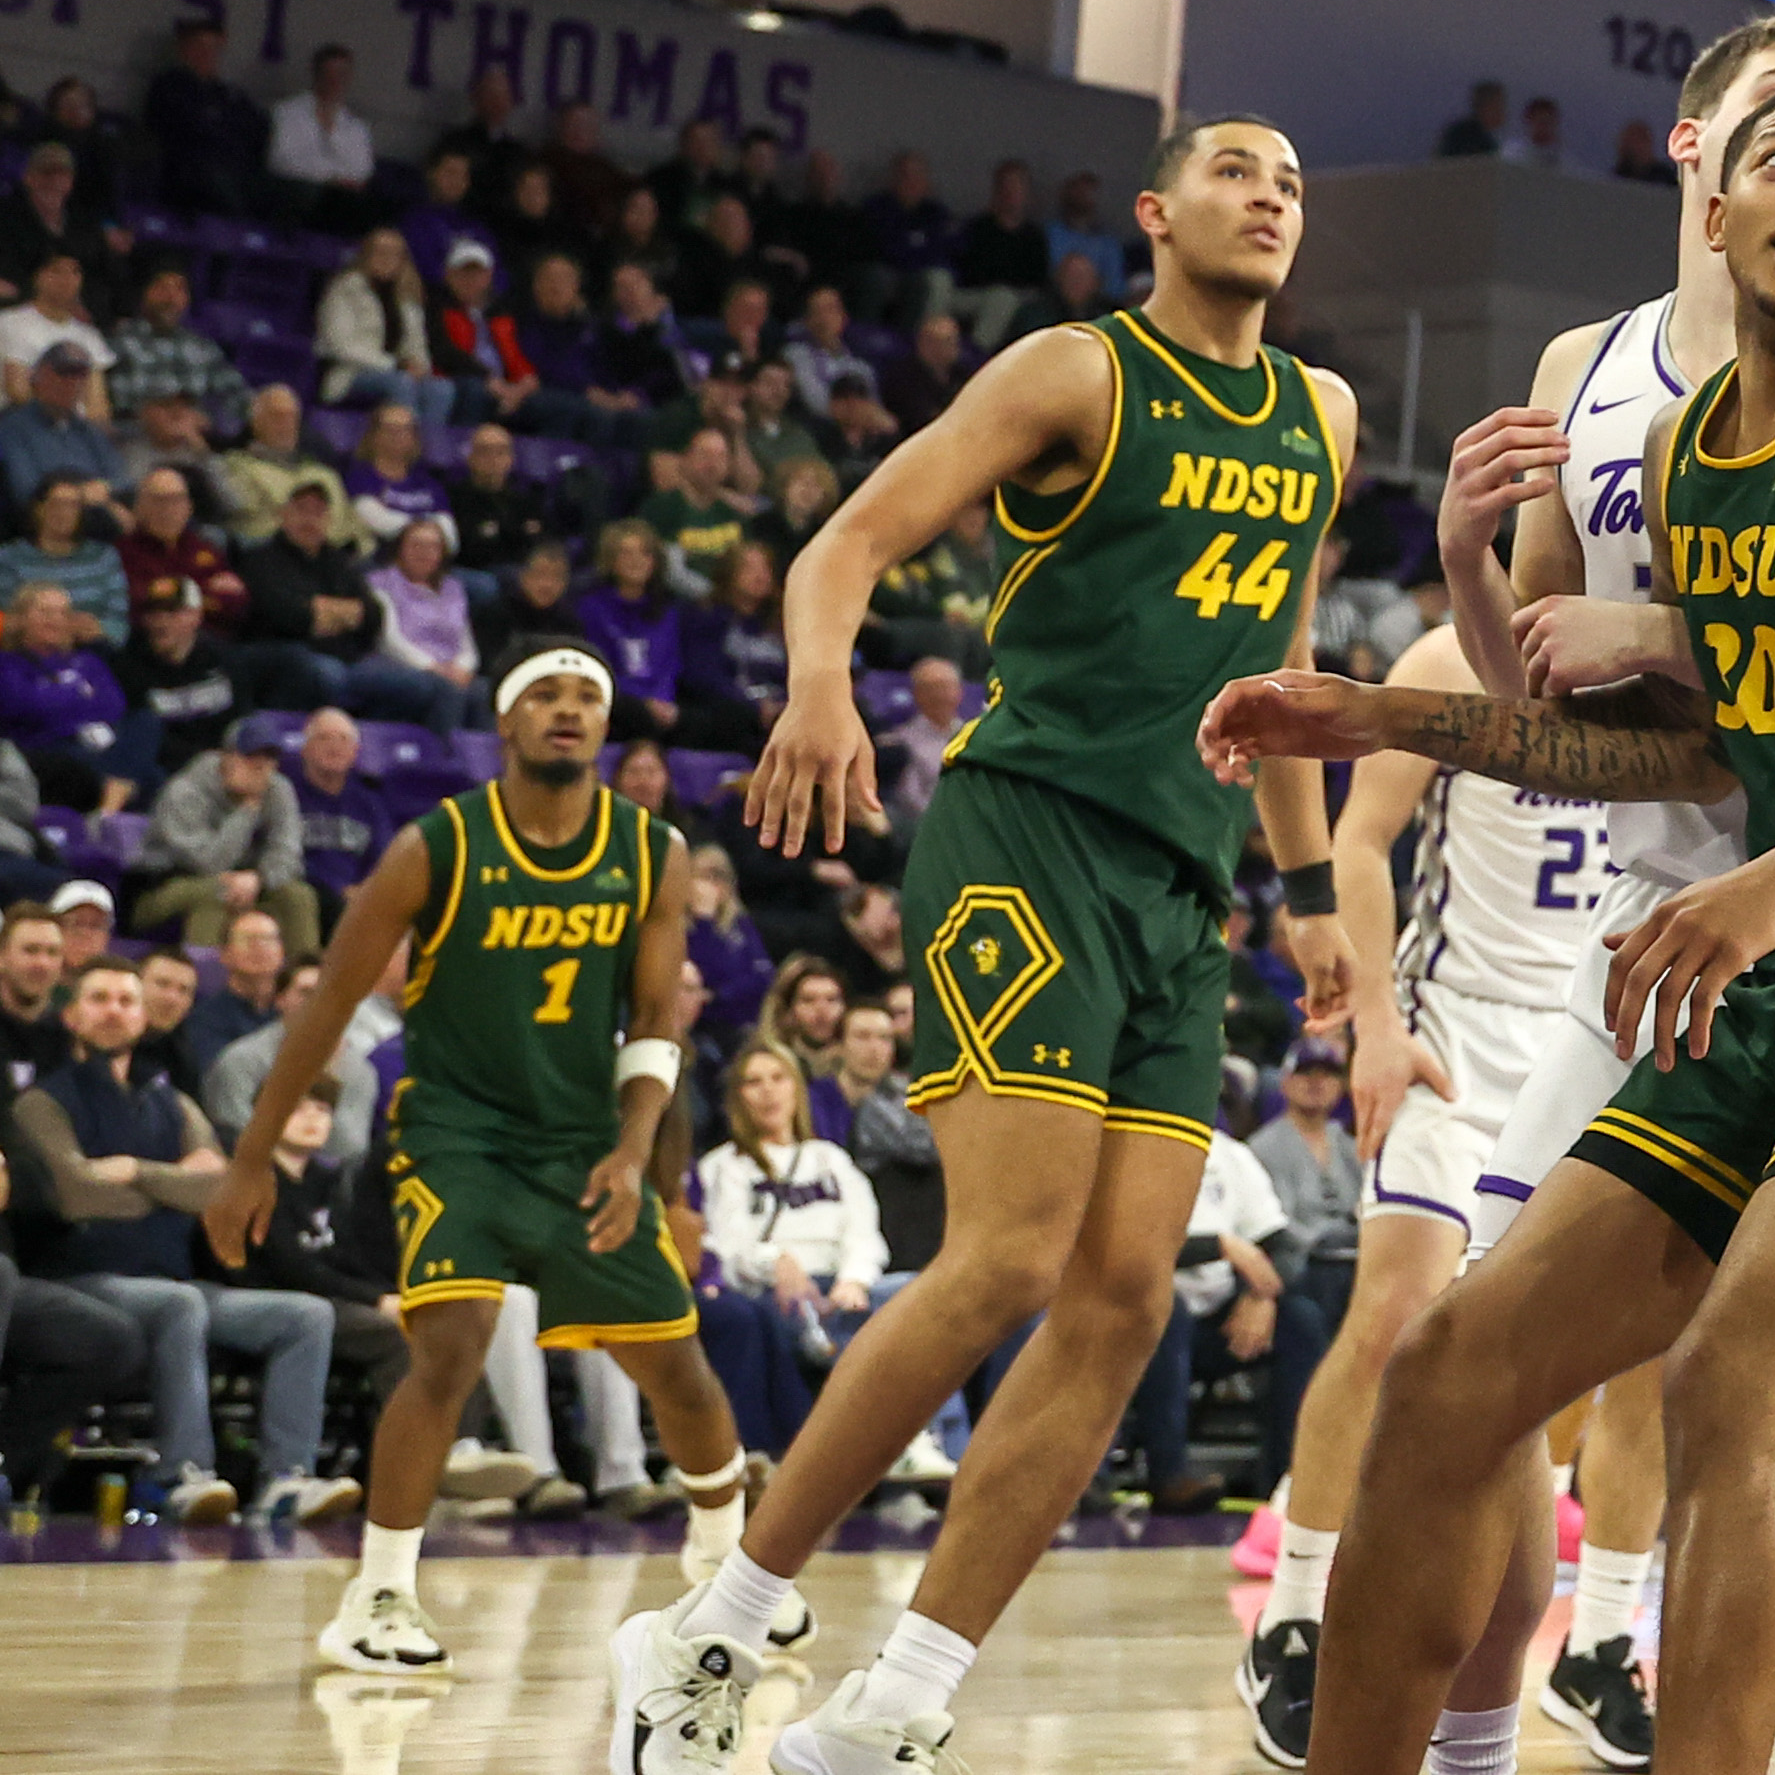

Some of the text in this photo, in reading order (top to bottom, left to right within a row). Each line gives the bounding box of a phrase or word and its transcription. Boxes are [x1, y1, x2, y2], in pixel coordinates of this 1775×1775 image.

[1605, 14, 1694, 82] 120
[1160, 452, 1319, 524] NDSU
[1175, 531, 1291, 622] 44
[482, 904, 629, 949] NDSU
[534, 957, 582, 1024] 1
